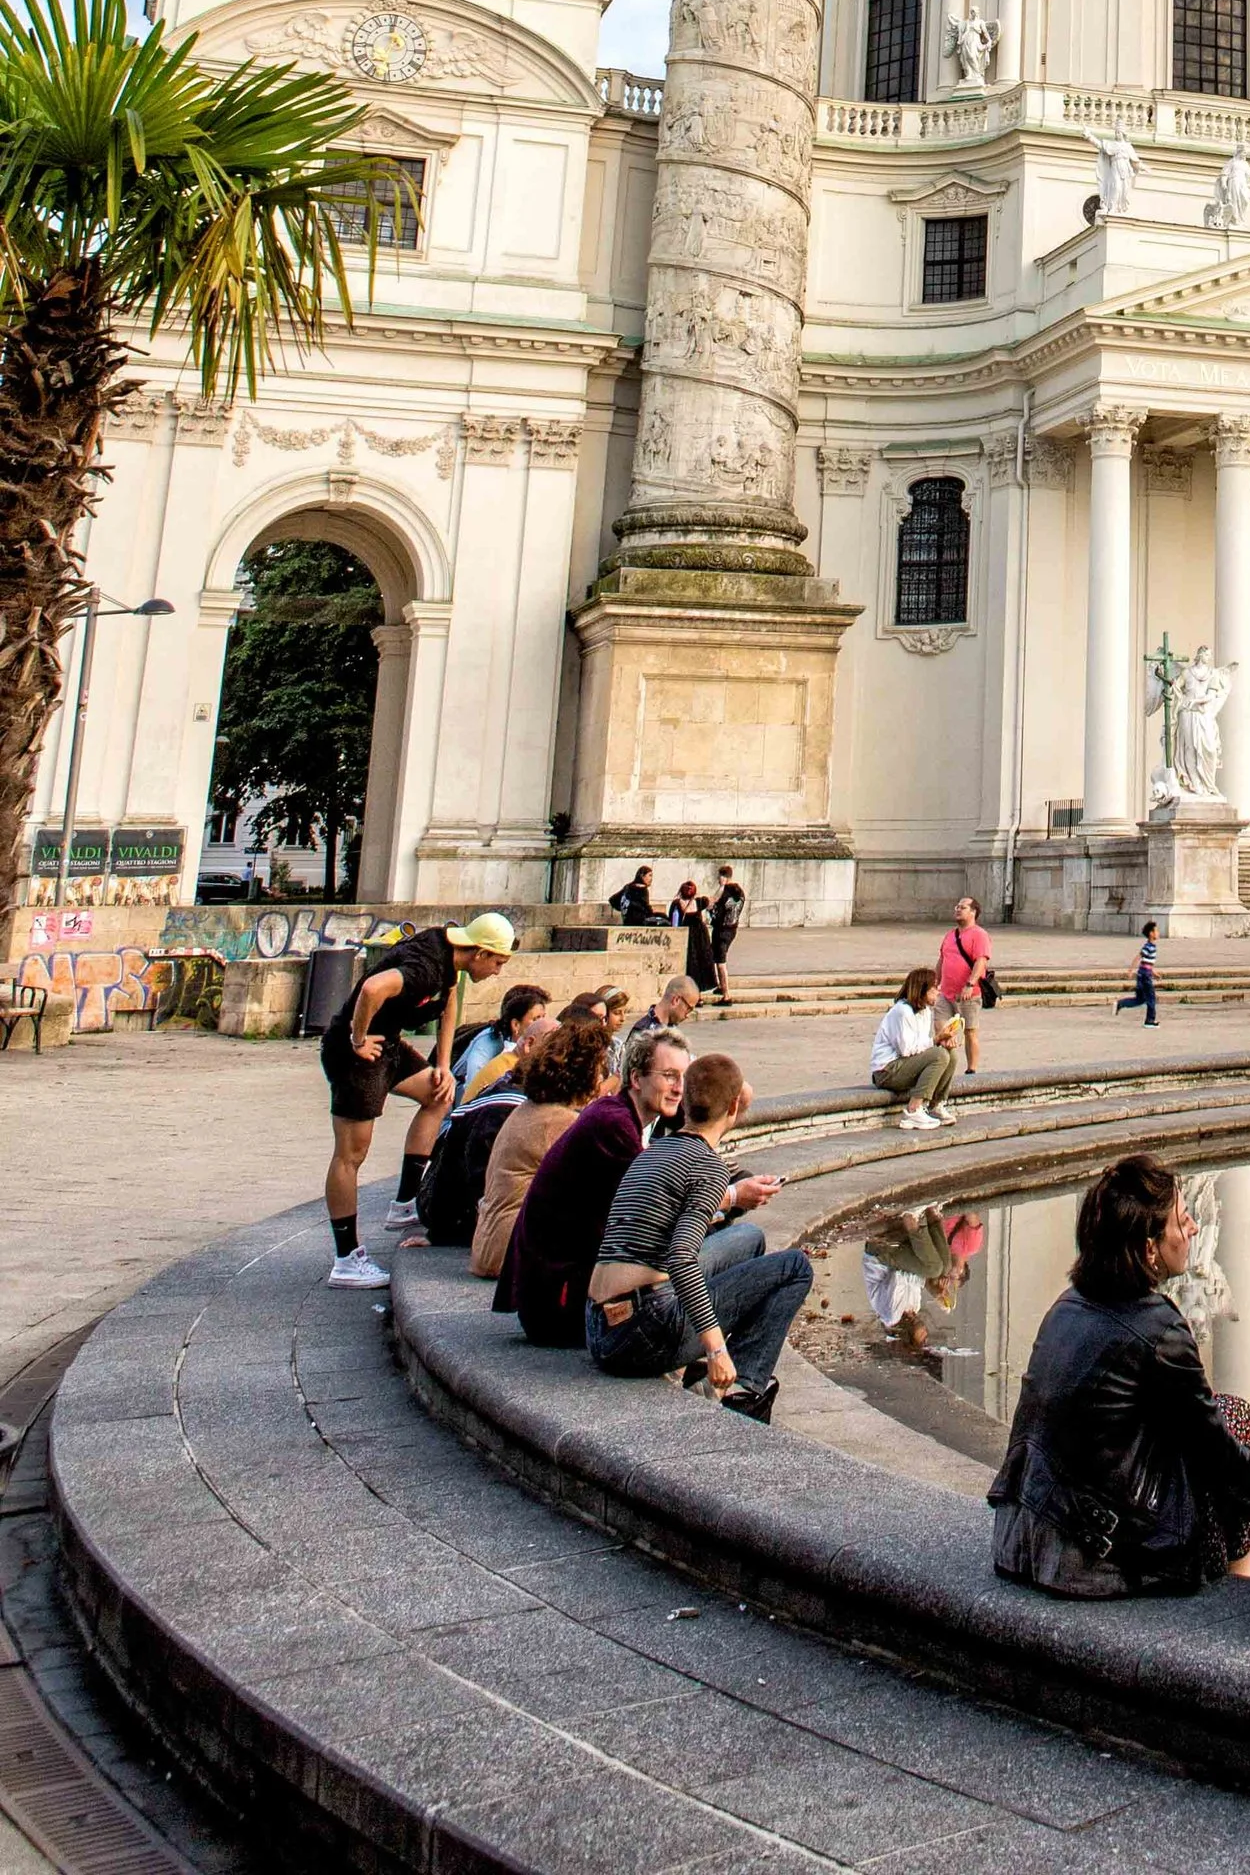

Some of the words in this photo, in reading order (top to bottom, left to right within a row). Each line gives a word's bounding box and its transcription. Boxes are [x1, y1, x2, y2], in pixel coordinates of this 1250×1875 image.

[1124, 354, 1182, 382] VOTA
[1199, 363, 1249, 388] MEA
[118, 845, 178, 858] VIVALDI
